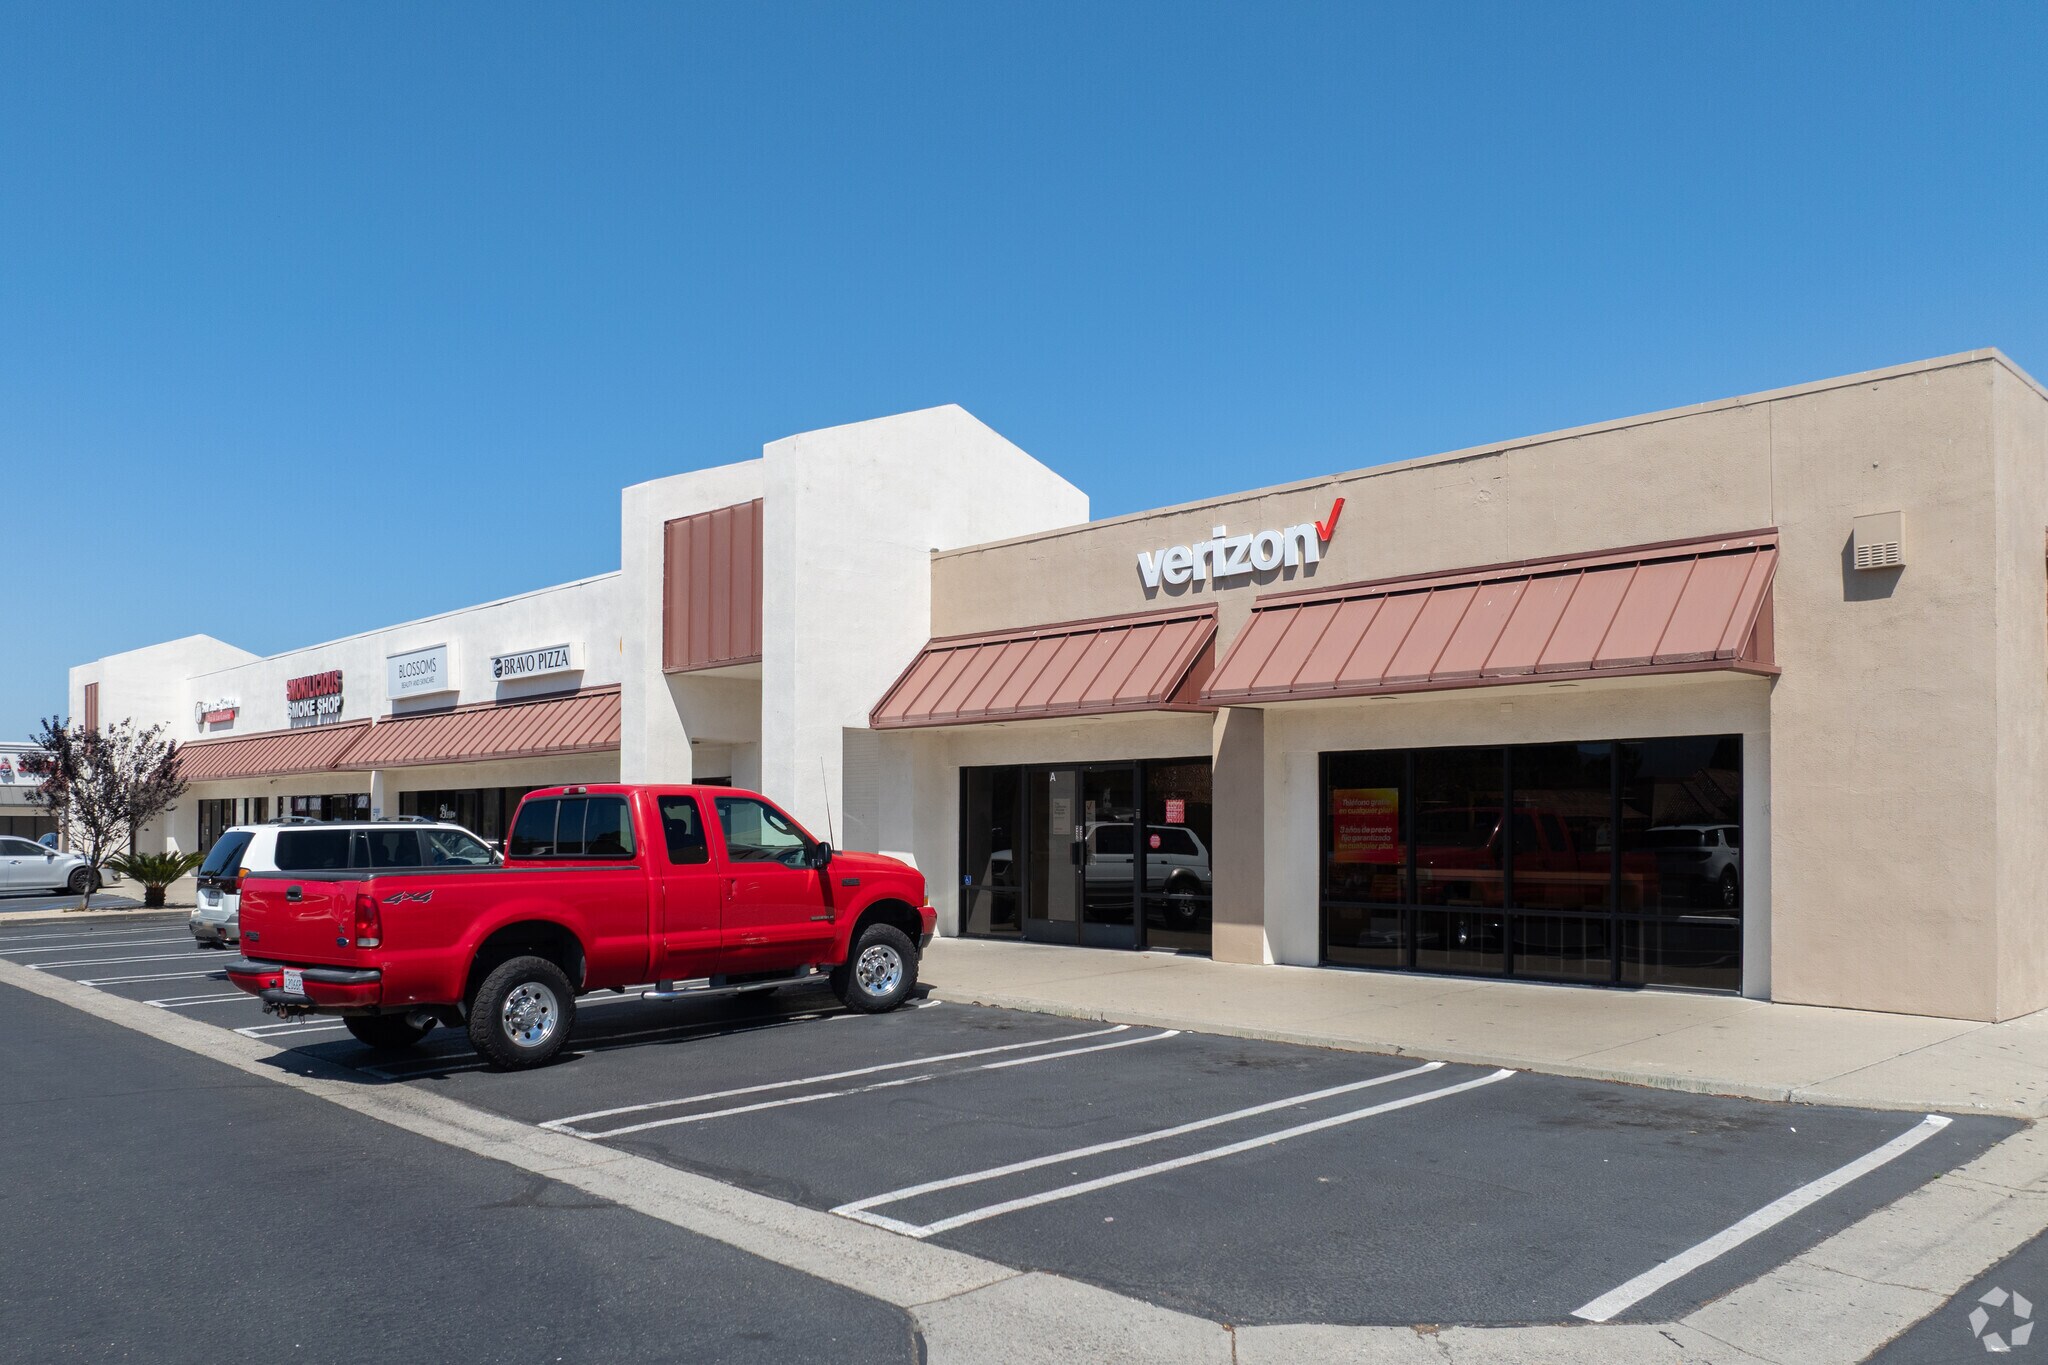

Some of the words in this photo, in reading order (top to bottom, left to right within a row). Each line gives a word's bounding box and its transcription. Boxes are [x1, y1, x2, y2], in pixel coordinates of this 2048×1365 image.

[1137, 523, 1320, 588] verizon
[398, 657, 437, 679] BLOSSOMS
[504, 654, 535, 675] BRAVO
[538, 649, 569, 670] PIZZA
[286, 670, 342, 701] SMOKILICIOUS
[287, 699, 316, 718] SMOKE
[316, 695, 342, 715] SHOP
[1049, 772, 1056, 782] A
[1352, 833, 1391, 842] garantizado
[1361, 825, 1370, 833] de
[1370, 826, 1392, 834] precio
[1347, 842, 1378, 850] cualquier
[1378, 842, 1393, 851] plan
